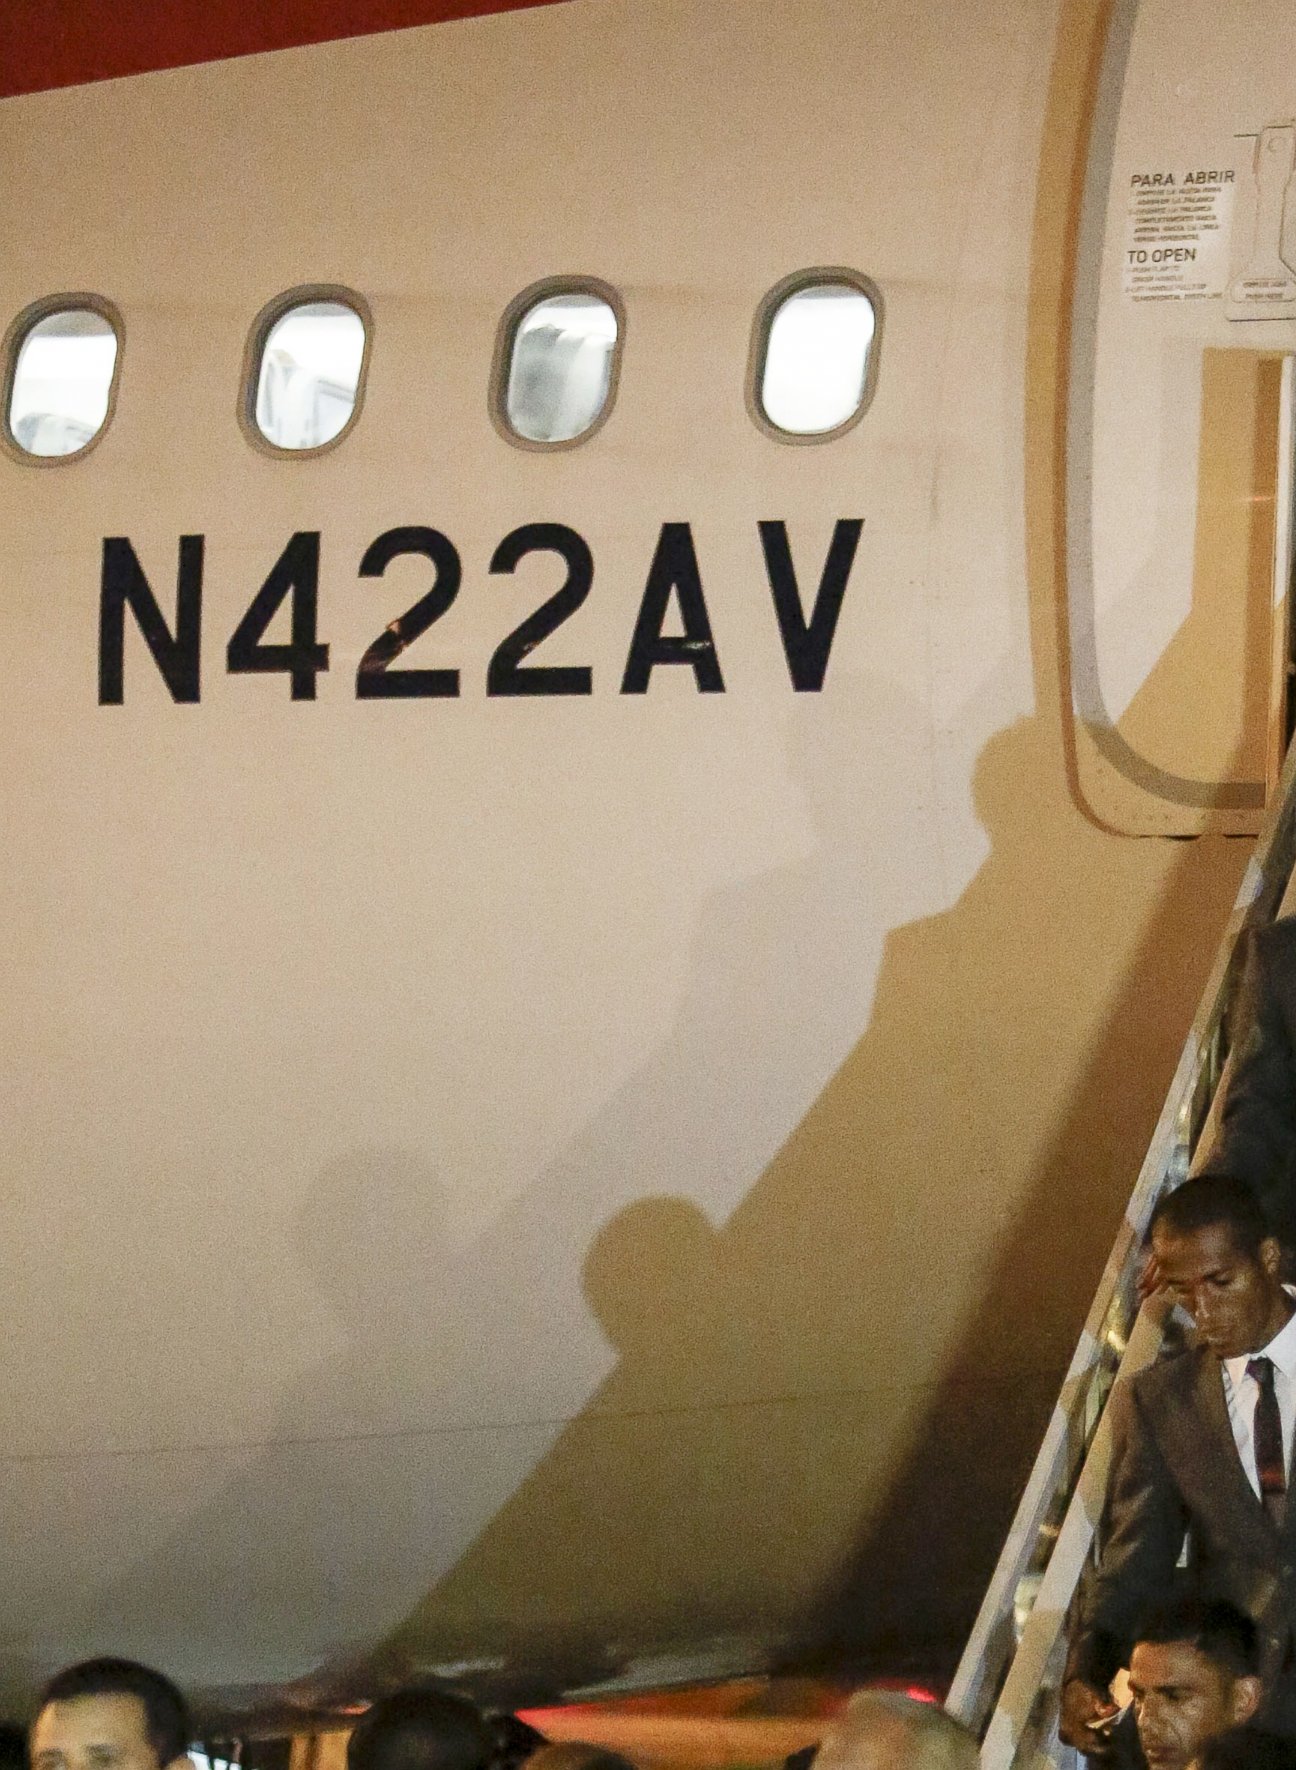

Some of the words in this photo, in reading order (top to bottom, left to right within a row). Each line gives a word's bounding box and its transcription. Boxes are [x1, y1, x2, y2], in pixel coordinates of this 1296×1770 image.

[1130, 173, 1175, 187] PARA
[1183, 169, 1236, 185] ABRIR
[1127, 250, 1148, 264] TO
[1151, 248, 1197, 263] OPEN
[97, 517, 865, 706] N422AV
